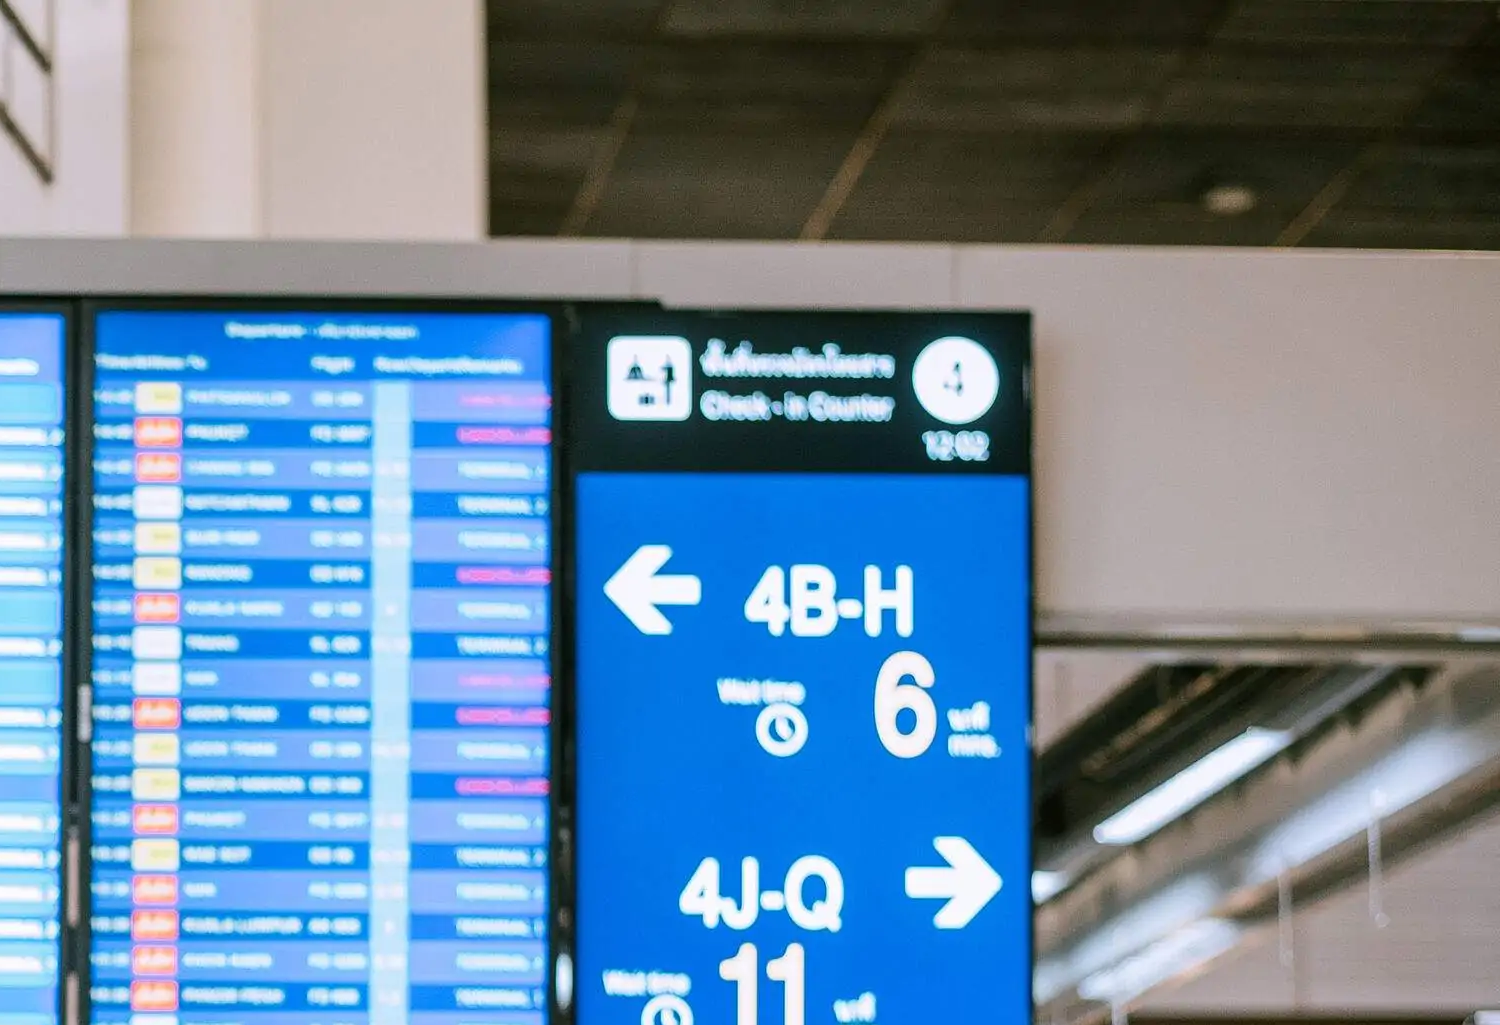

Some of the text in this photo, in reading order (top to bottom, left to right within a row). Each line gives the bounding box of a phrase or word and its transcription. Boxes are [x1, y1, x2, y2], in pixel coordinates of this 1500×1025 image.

[744, 564, 914, 637] 4B-H
[874, 650, 937, 758] 6
[679, 855, 844, 932] 4J-Q
